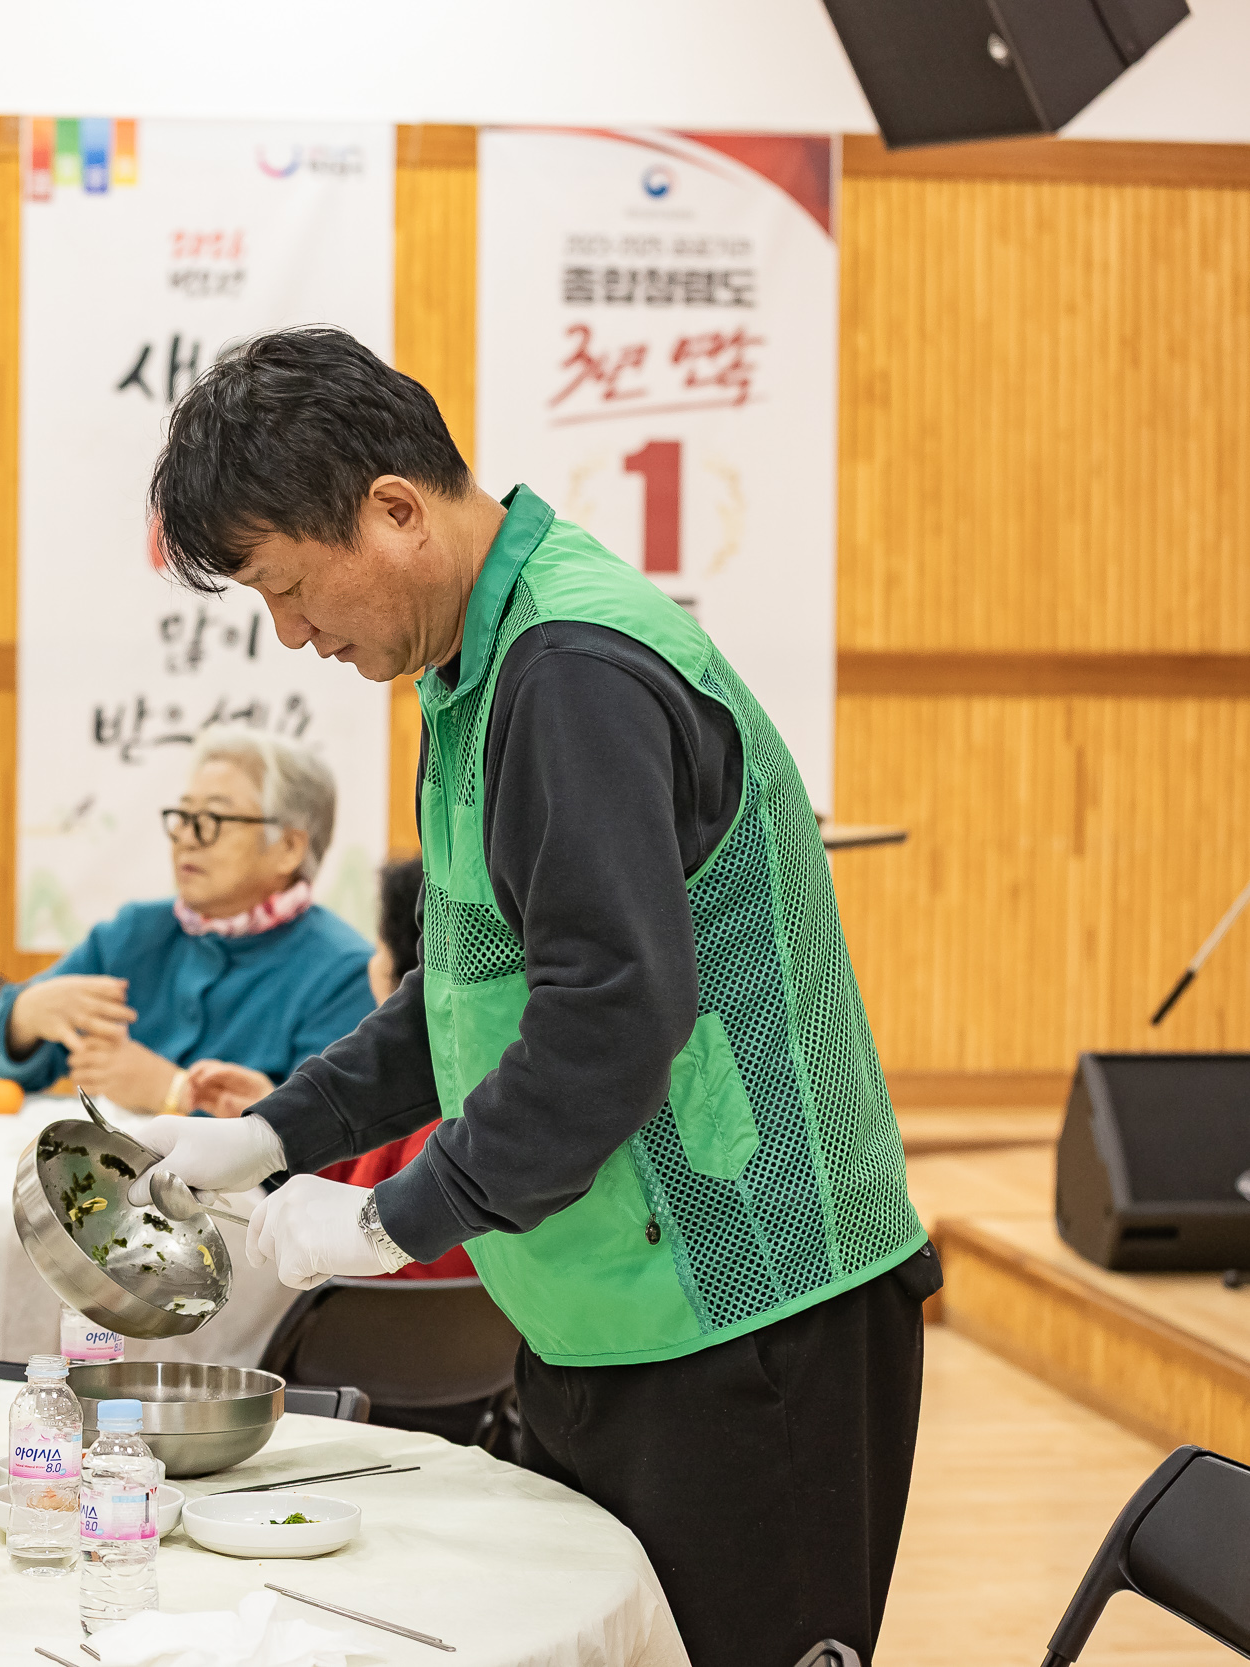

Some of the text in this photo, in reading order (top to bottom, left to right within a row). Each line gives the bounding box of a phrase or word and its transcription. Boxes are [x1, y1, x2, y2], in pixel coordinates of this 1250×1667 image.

[623, 439, 682, 573] 1
[15, 1446, 62, 1462] 아이시스
[45, 1463, 62, 1473] 8.0
[85, 1520, 98, 1531] 8.0
